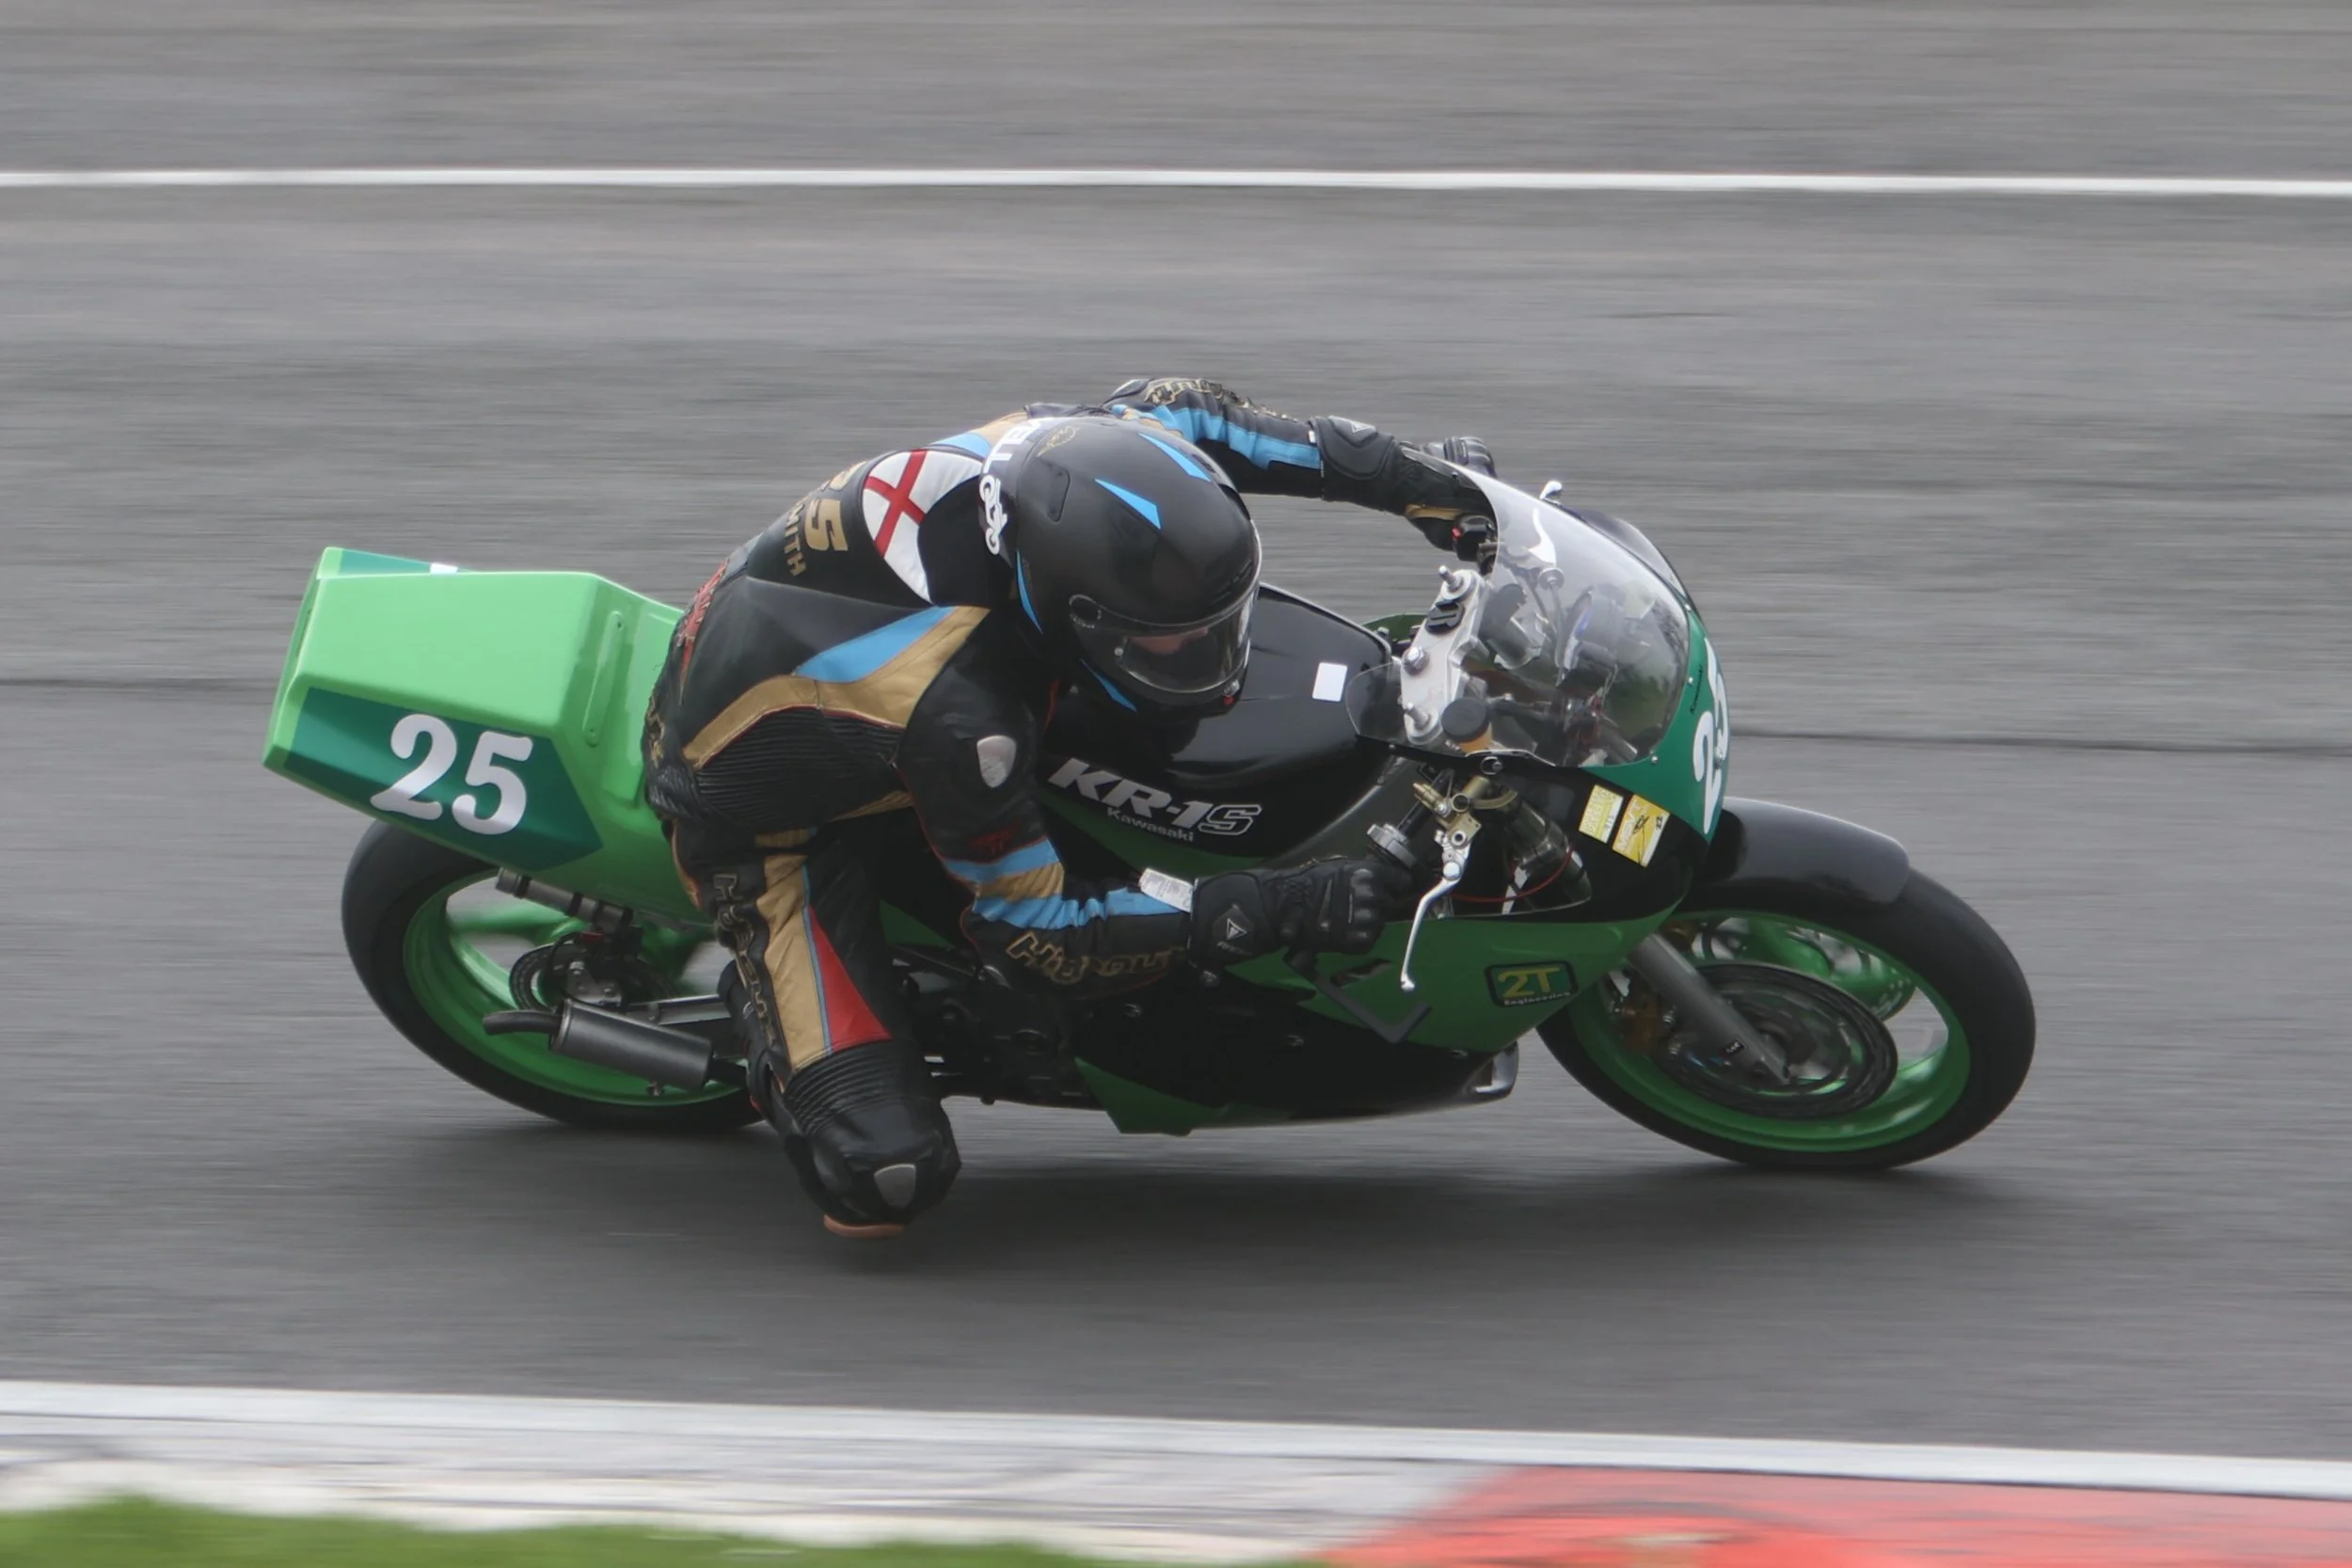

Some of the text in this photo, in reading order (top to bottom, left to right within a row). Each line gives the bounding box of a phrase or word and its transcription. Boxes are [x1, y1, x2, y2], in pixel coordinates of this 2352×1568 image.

[370, 714, 533, 835] 25
[1693, 637, 1729, 834] 25
[1048, 757, 1262, 836] KR-1S
[1107, 806, 1195, 843] Kawasaki
[1497, 967, 1561, 998] 2T
